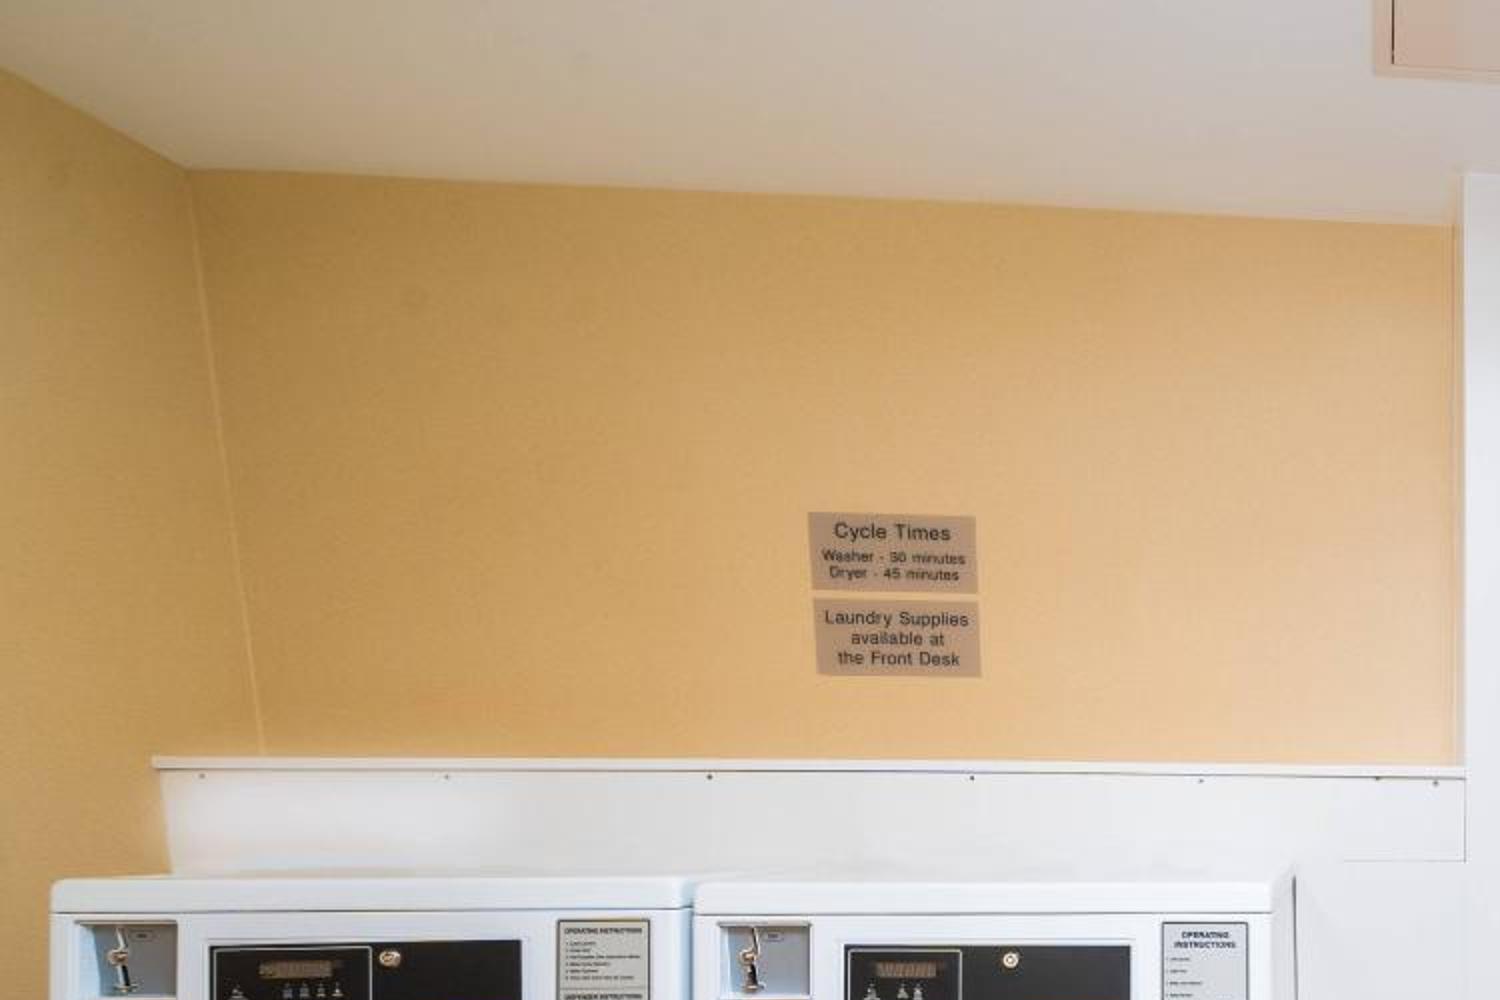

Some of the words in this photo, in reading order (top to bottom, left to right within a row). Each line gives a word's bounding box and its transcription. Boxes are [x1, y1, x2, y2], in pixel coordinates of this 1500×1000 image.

[834, 521, 888, 543] Cycle
[894, 523, 952, 541] Times
[821, 549, 874, 563] Washer
[912, 551, 966, 566] minutes
[829, 565, 867, 581] Dryer
[883, 567, 901, 580] 45
[905, 568, 960, 582] minutes
[824, 609, 893, 629] Laundry
[899, 611, 969, 630] Supplies
[851, 631, 923, 646] available
[929, 633, 945, 647] at
[837, 651, 864, 666] the
[871, 651, 913, 666] Front
[919, 652, 961, 667] Desk
